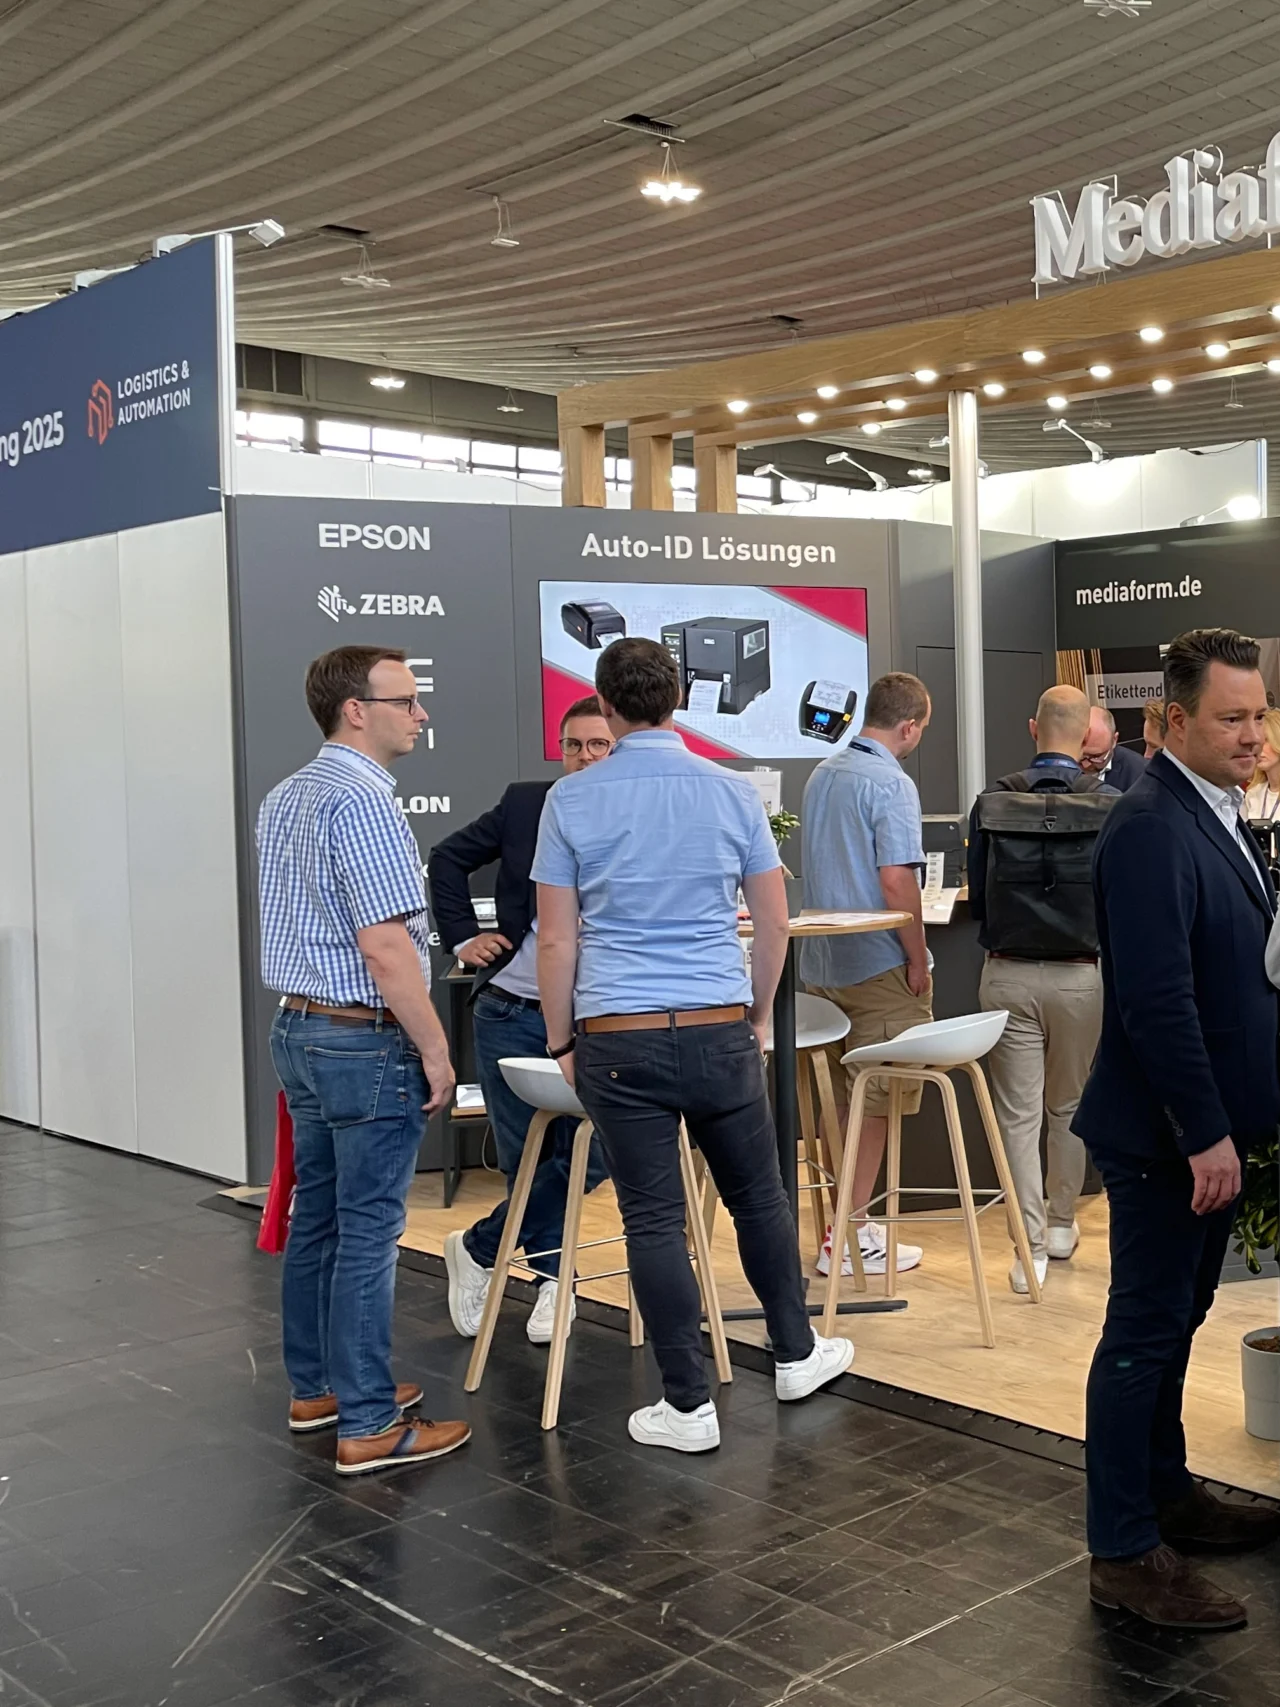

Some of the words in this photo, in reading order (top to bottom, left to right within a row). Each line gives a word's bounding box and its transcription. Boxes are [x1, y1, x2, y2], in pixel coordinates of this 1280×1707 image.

[117, 365, 178, 399] LOGISTICS
[181, 360, 190, 379] &
[117, 387, 191, 426] AUTOMATION
[22, 411, 64, 454] 2025
[318, 523, 431, 551] EPSON
[581, 533, 693, 560] Auto-ID
[702, 536, 836, 568] Lösungen
[360, 594, 445, 616] ZEBRA
[1076, 575, 1202, 605] mediaform.de
